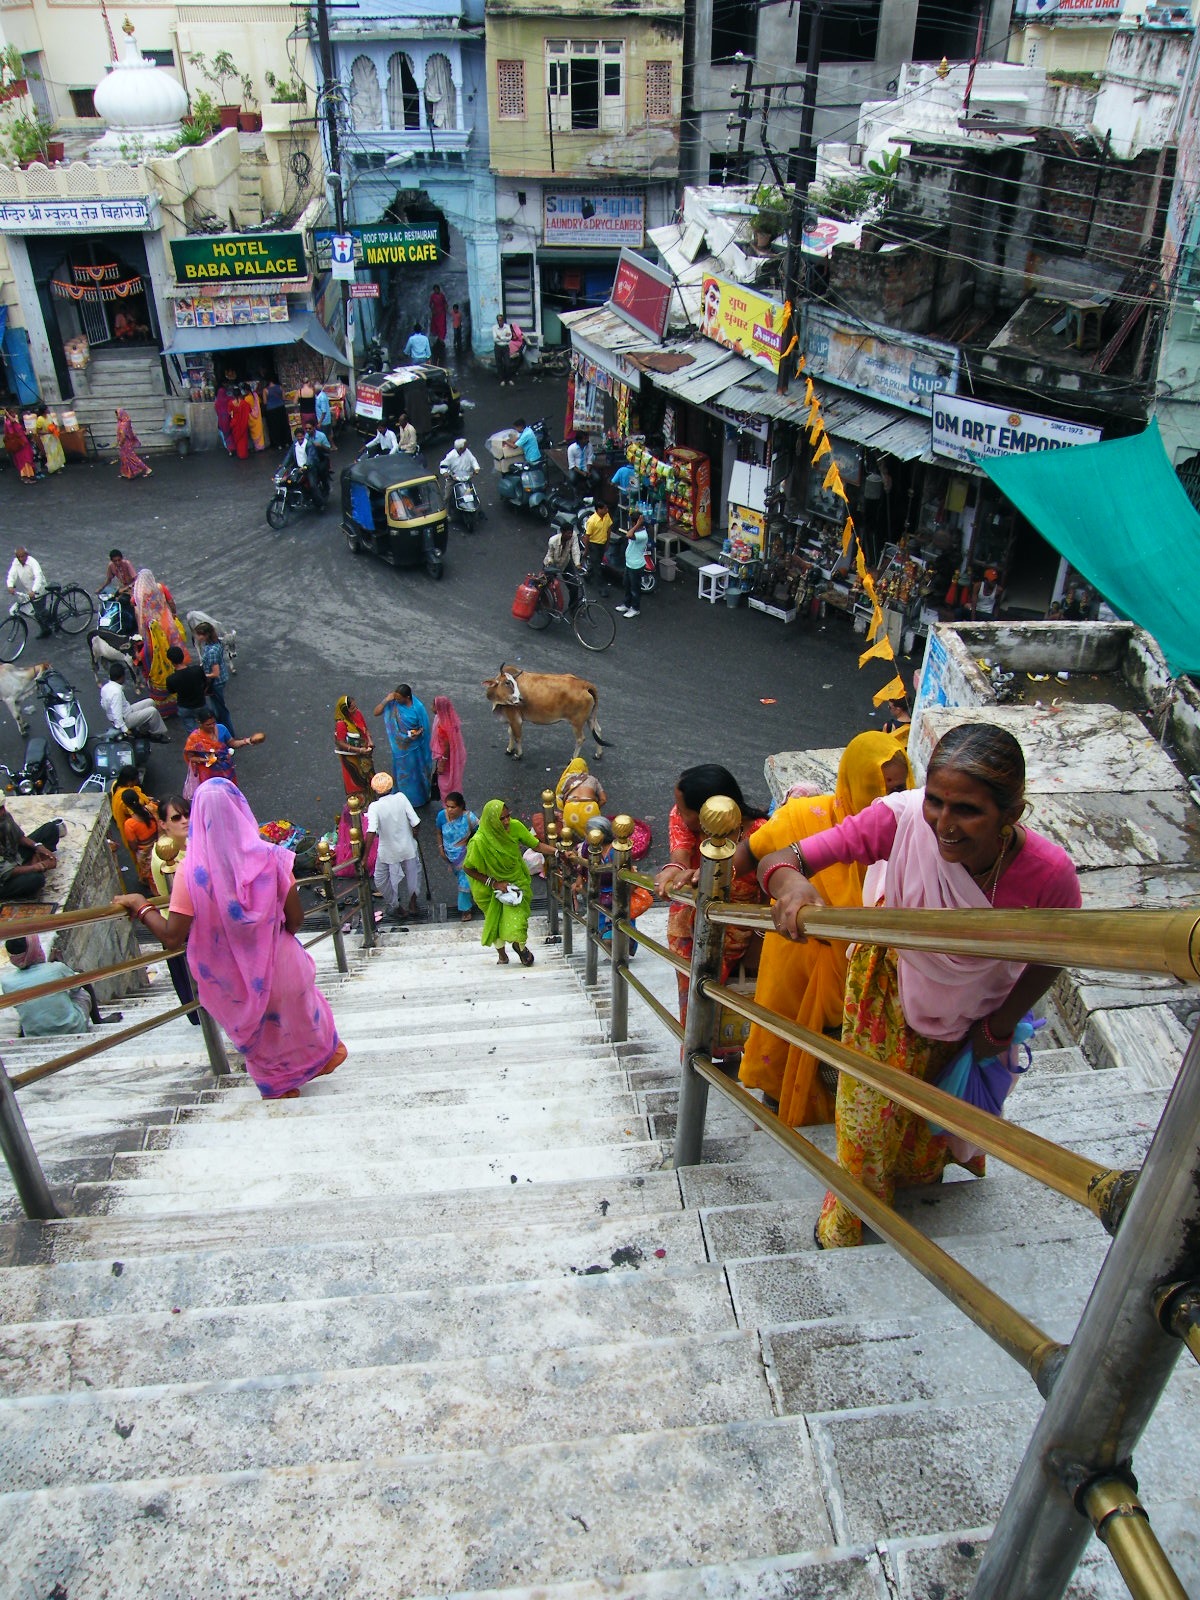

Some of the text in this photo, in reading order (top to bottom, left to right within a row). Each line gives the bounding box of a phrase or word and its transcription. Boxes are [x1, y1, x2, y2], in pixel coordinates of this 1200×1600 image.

[546, 196, 642, 217] Sunright
[363, 233, 377, 243] ROOF
[378, 232, 388, 242] TOP
[389, 232, 394, 242] &
[404, 229, 437, 241] RESTAURANT
[212, 241, 268, 257] HOTEL
[367, 246, 406, 264] MAYUR
[185, 259, 297, 278] BABA PALACE
[754, 327, 780, 348] Amul
[934, 410, 959, 435] OM
[962, 419, 996, 445] ART
